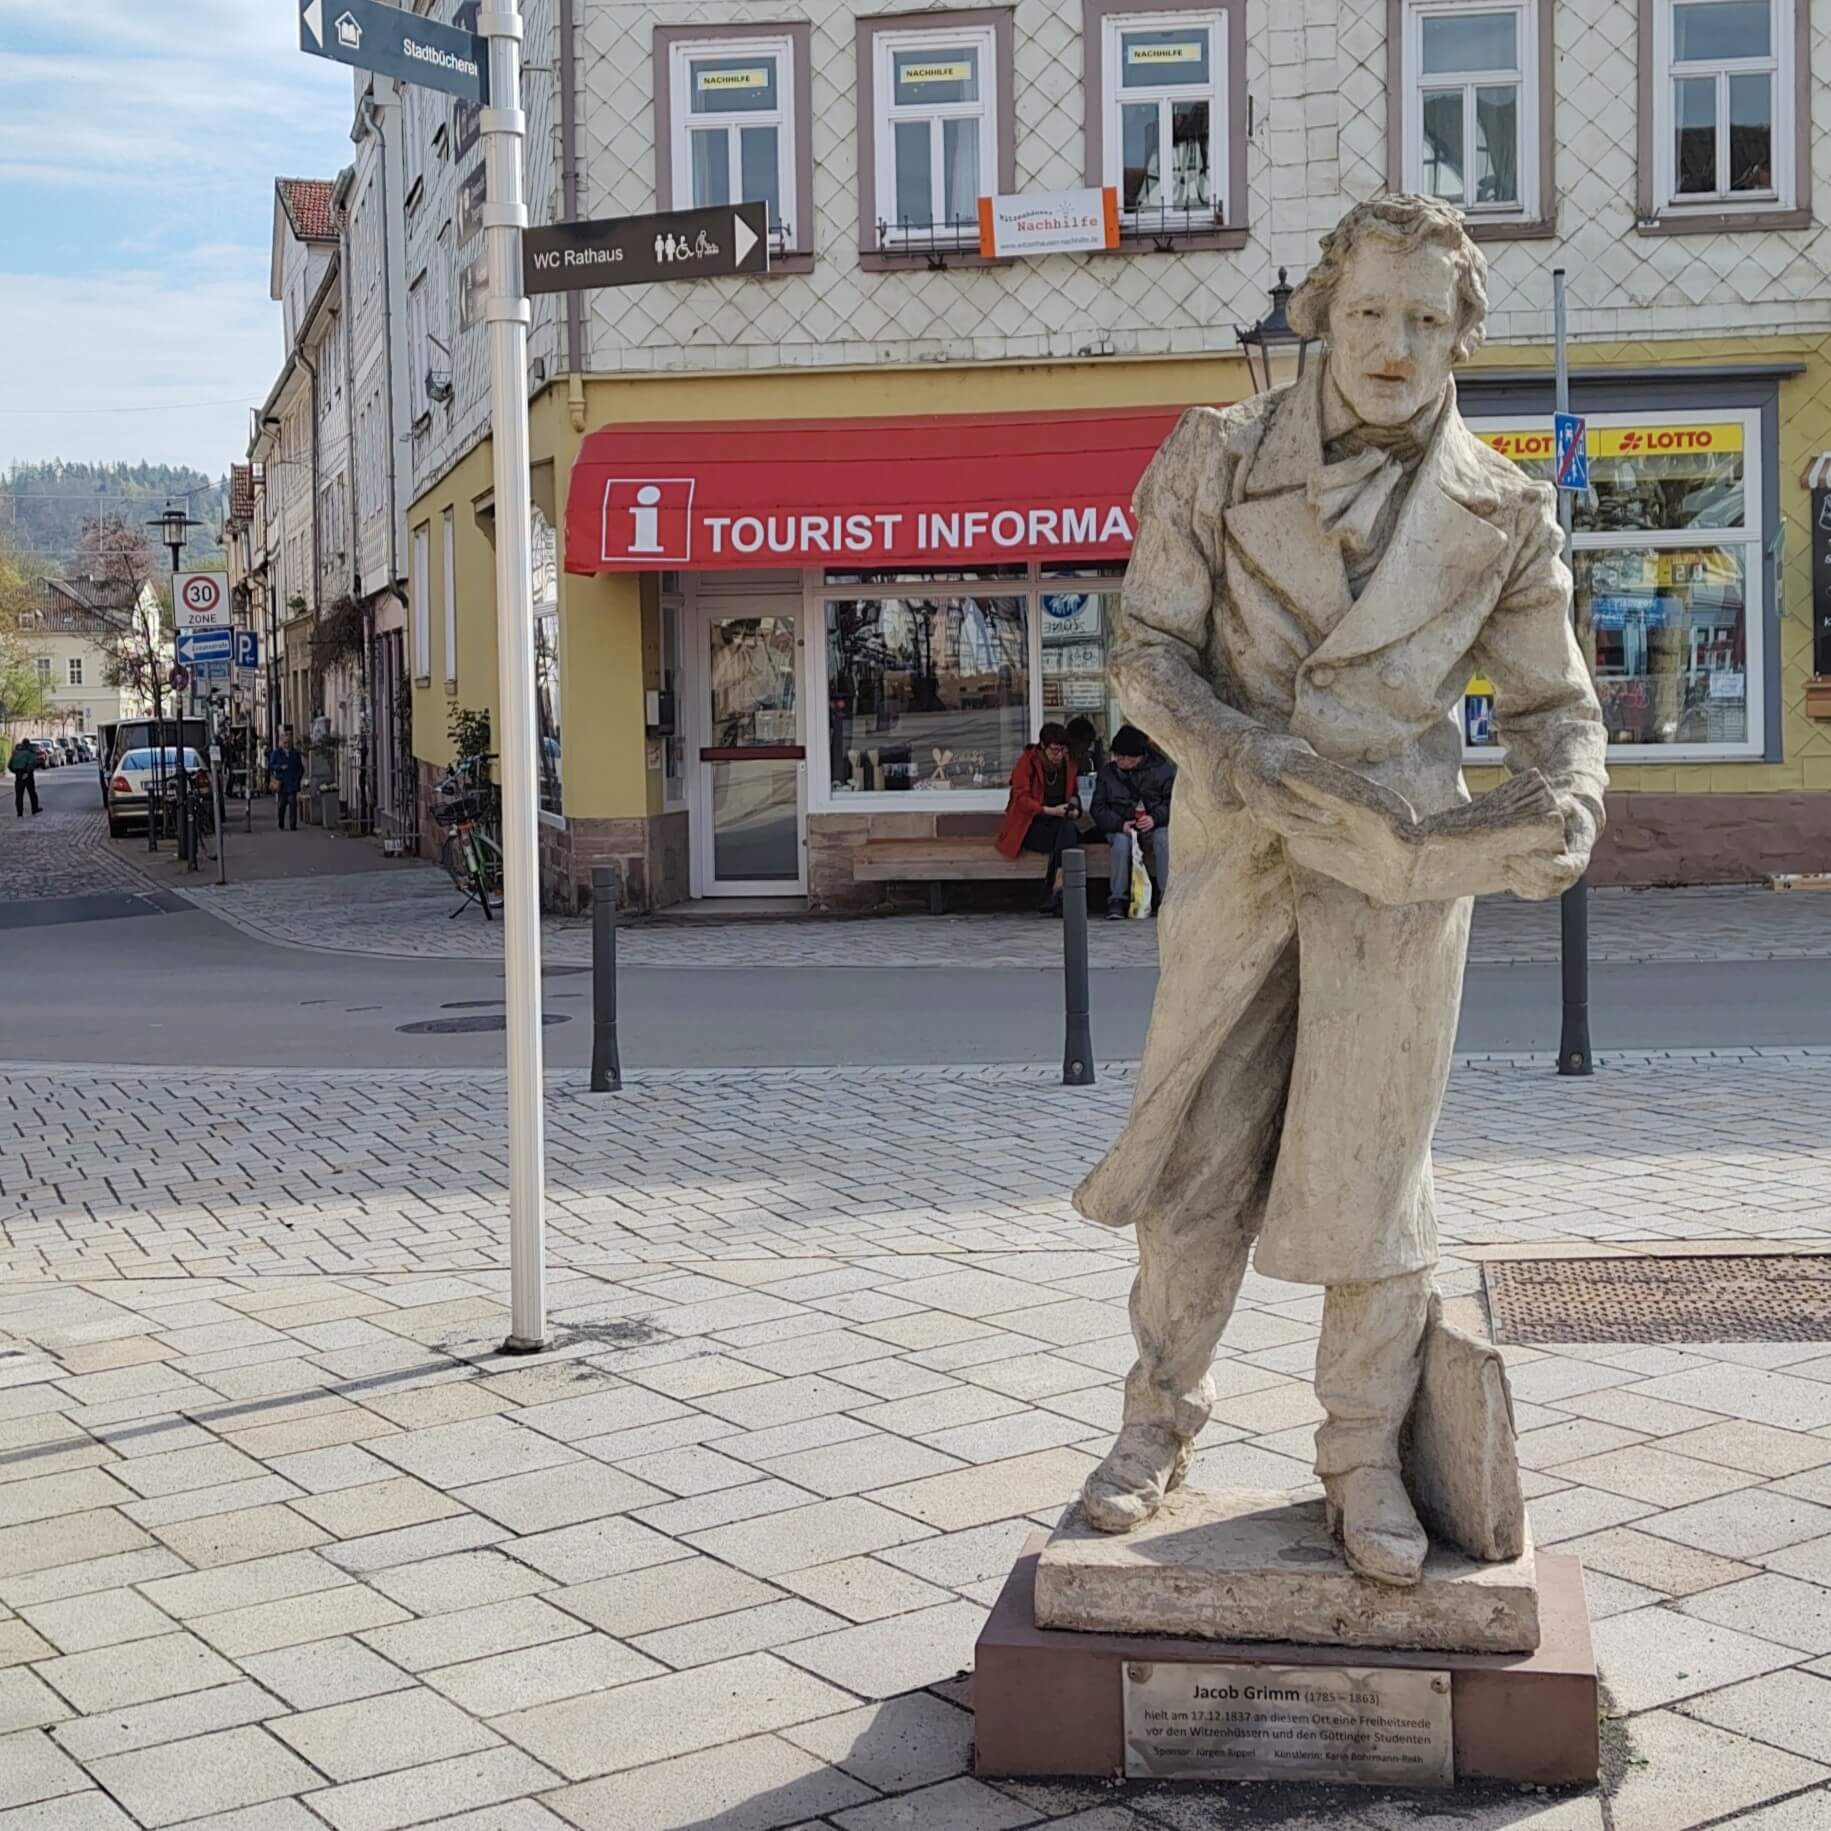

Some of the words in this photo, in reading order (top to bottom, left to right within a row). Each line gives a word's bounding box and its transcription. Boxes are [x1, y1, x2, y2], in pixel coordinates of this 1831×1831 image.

[403, 38, 478, 77] Stadtbücherei
[1134, 48, 1183, 58] NACHHILFE
[703, 75, 751, 84] NACHHILFE
[906, 67, 954, 77] NACHHILFE
[1017, 216, 1098, 232] Nachhilfe
[533, 250, 560, 270] WC
[564, 247, 624, 267] Rathaus
[1515, 437, 1555, 453] LOT
[1647, 431, 1712, 449] LOTTO
[703, 514, 902, 553] TOURIST
[917, 505, 1136, 549] INFORMA
[190, 586, 212, 602] 30
[188, 614, 217, 624] ZONE
[239, 635, 252, 664] P
[1193, 1685, 1239, 1700] Jacob
[1244, 1686, 1300, 1701] Grimm
[1304, 1692, 1336, 1704] (1785
[1350, 1694, 1380, 1706] 1863)
[1144, 1710, 1168, 1721] hielt
[1171, 1712, 1188, 1721] am
[1191, 1711, 1251, 1722] 17.12.1837
[1254, 1713, 1268, 1722] an
[1270, 1712, 1309, 1724] diesem
[1311, 1713, 1331, 1725] Ort
[1333, 1715, 1357, 1726] eine
[1359, 1716, 1432, 1729] Freiheitsrede
[1145, 1727, 1163, 1737] vor
[1166, 1726, 1187, 1737] den
[1272, 1728, 1293, 1739] und
[1296, 1729, 1317, 1740] den
[1320, 1730, 1371, 1744] Göttinger
[1374, 1732, 1432, 1745] Studenten
